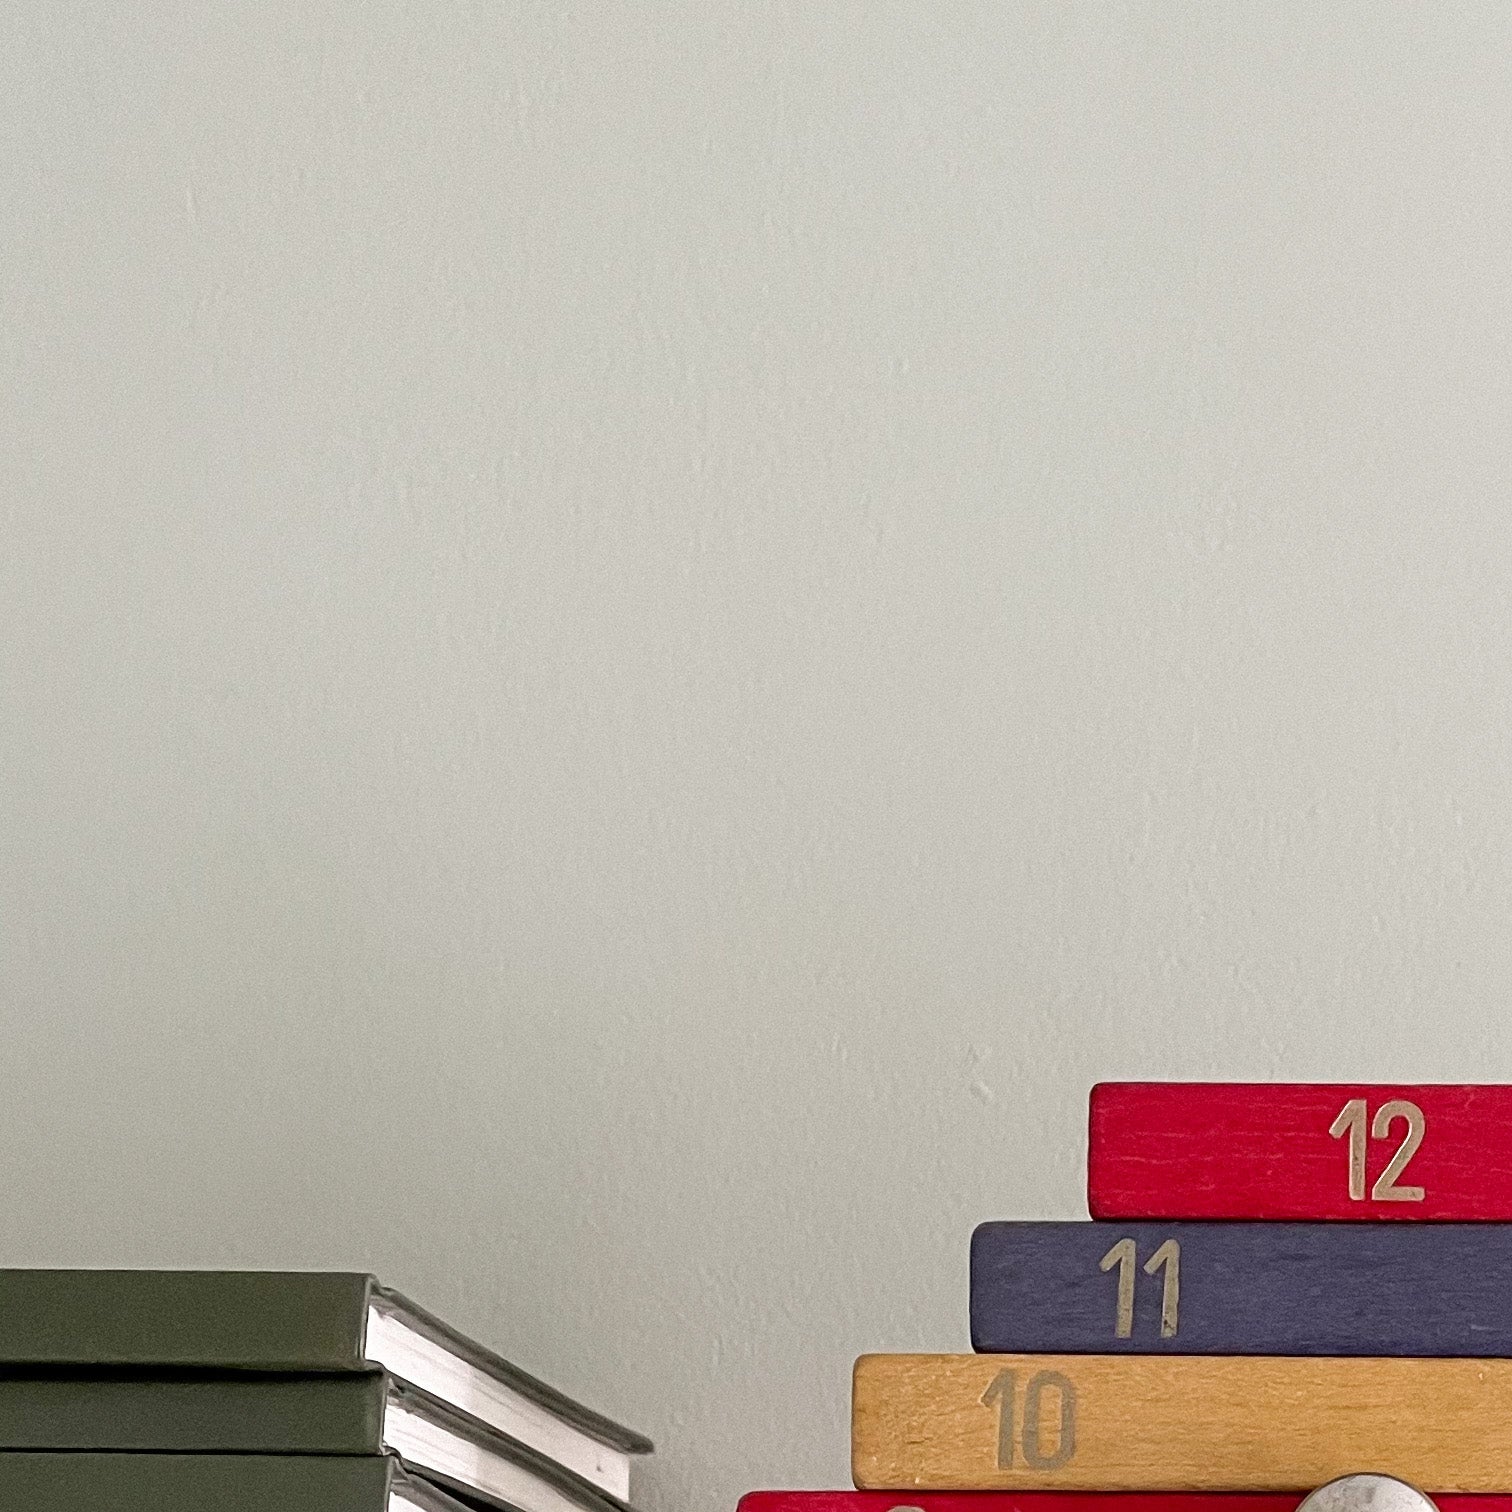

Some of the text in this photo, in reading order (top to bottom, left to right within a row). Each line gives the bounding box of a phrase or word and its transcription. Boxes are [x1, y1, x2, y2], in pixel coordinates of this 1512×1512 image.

[1328, 1098, 1427, 1203] 12
[1099, 1237, 1181, 1340] 11
[980, 1367, 1077, 1472] 10
